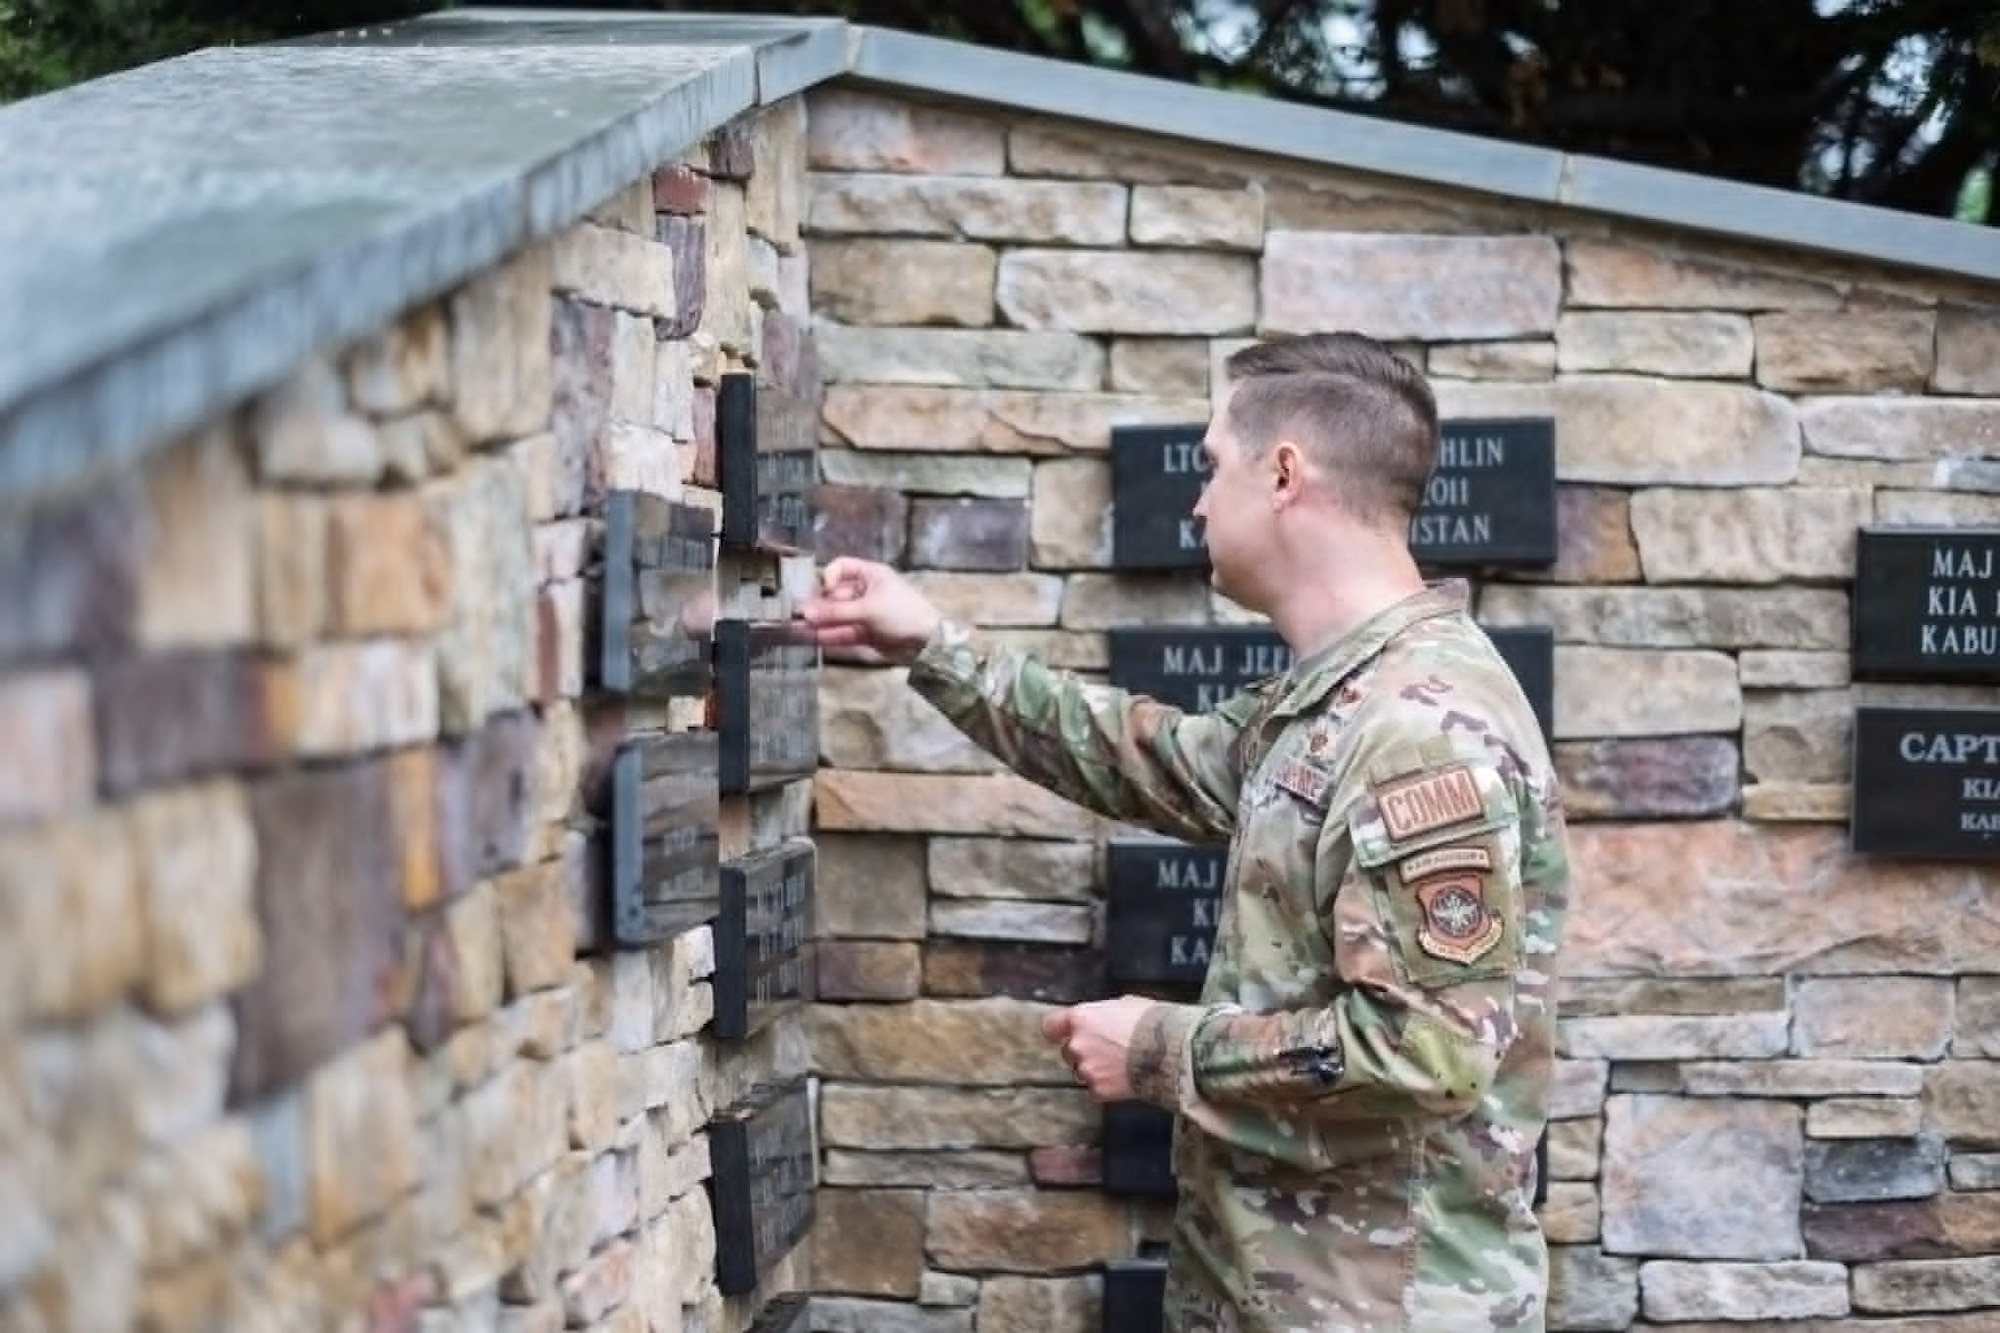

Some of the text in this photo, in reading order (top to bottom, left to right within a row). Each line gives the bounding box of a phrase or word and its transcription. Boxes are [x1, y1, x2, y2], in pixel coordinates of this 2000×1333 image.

[1440, 437, 1503, 468] HLIN
[1411, 514, 1490, 544] ISTAN
[1933, 549, 1993, 578] MAJ
[1928, 586, 1977, 616] KIA
[1921, 625, 1998, 655] KABU
[1163, 646, 1223, 675] MAJ
[1900, 733, 2000, 763] CAPT
[1388, 772, 1476, 832] COMM
[1158, 859, 1218, 889] MAJ
